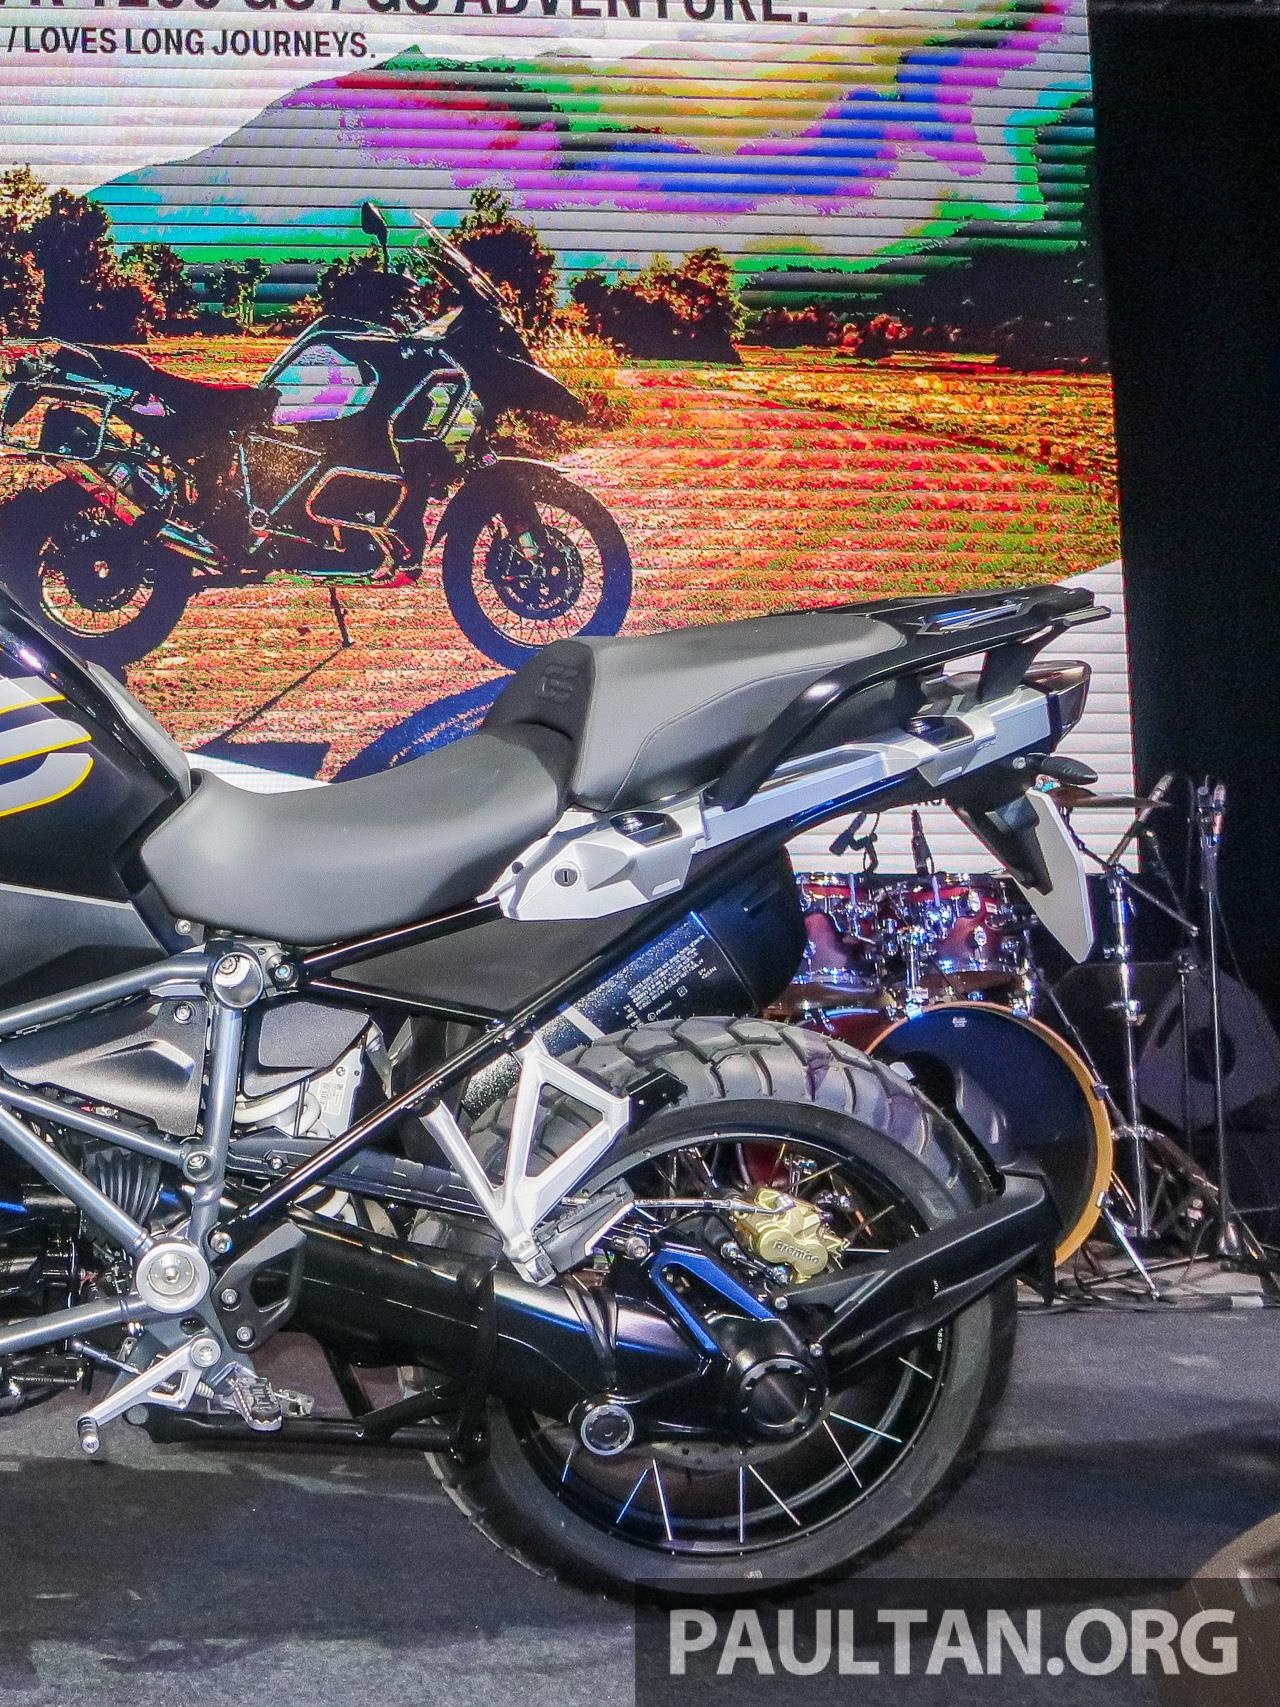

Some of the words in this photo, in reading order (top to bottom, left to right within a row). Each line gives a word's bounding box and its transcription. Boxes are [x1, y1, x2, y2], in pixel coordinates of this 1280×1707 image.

[7, 26, 17, 52] /
[24, 26, 117, 54] LOVES
[126, 28, 204, 56] LONG
[212, 29, 376, 58] JOURNEYS.
